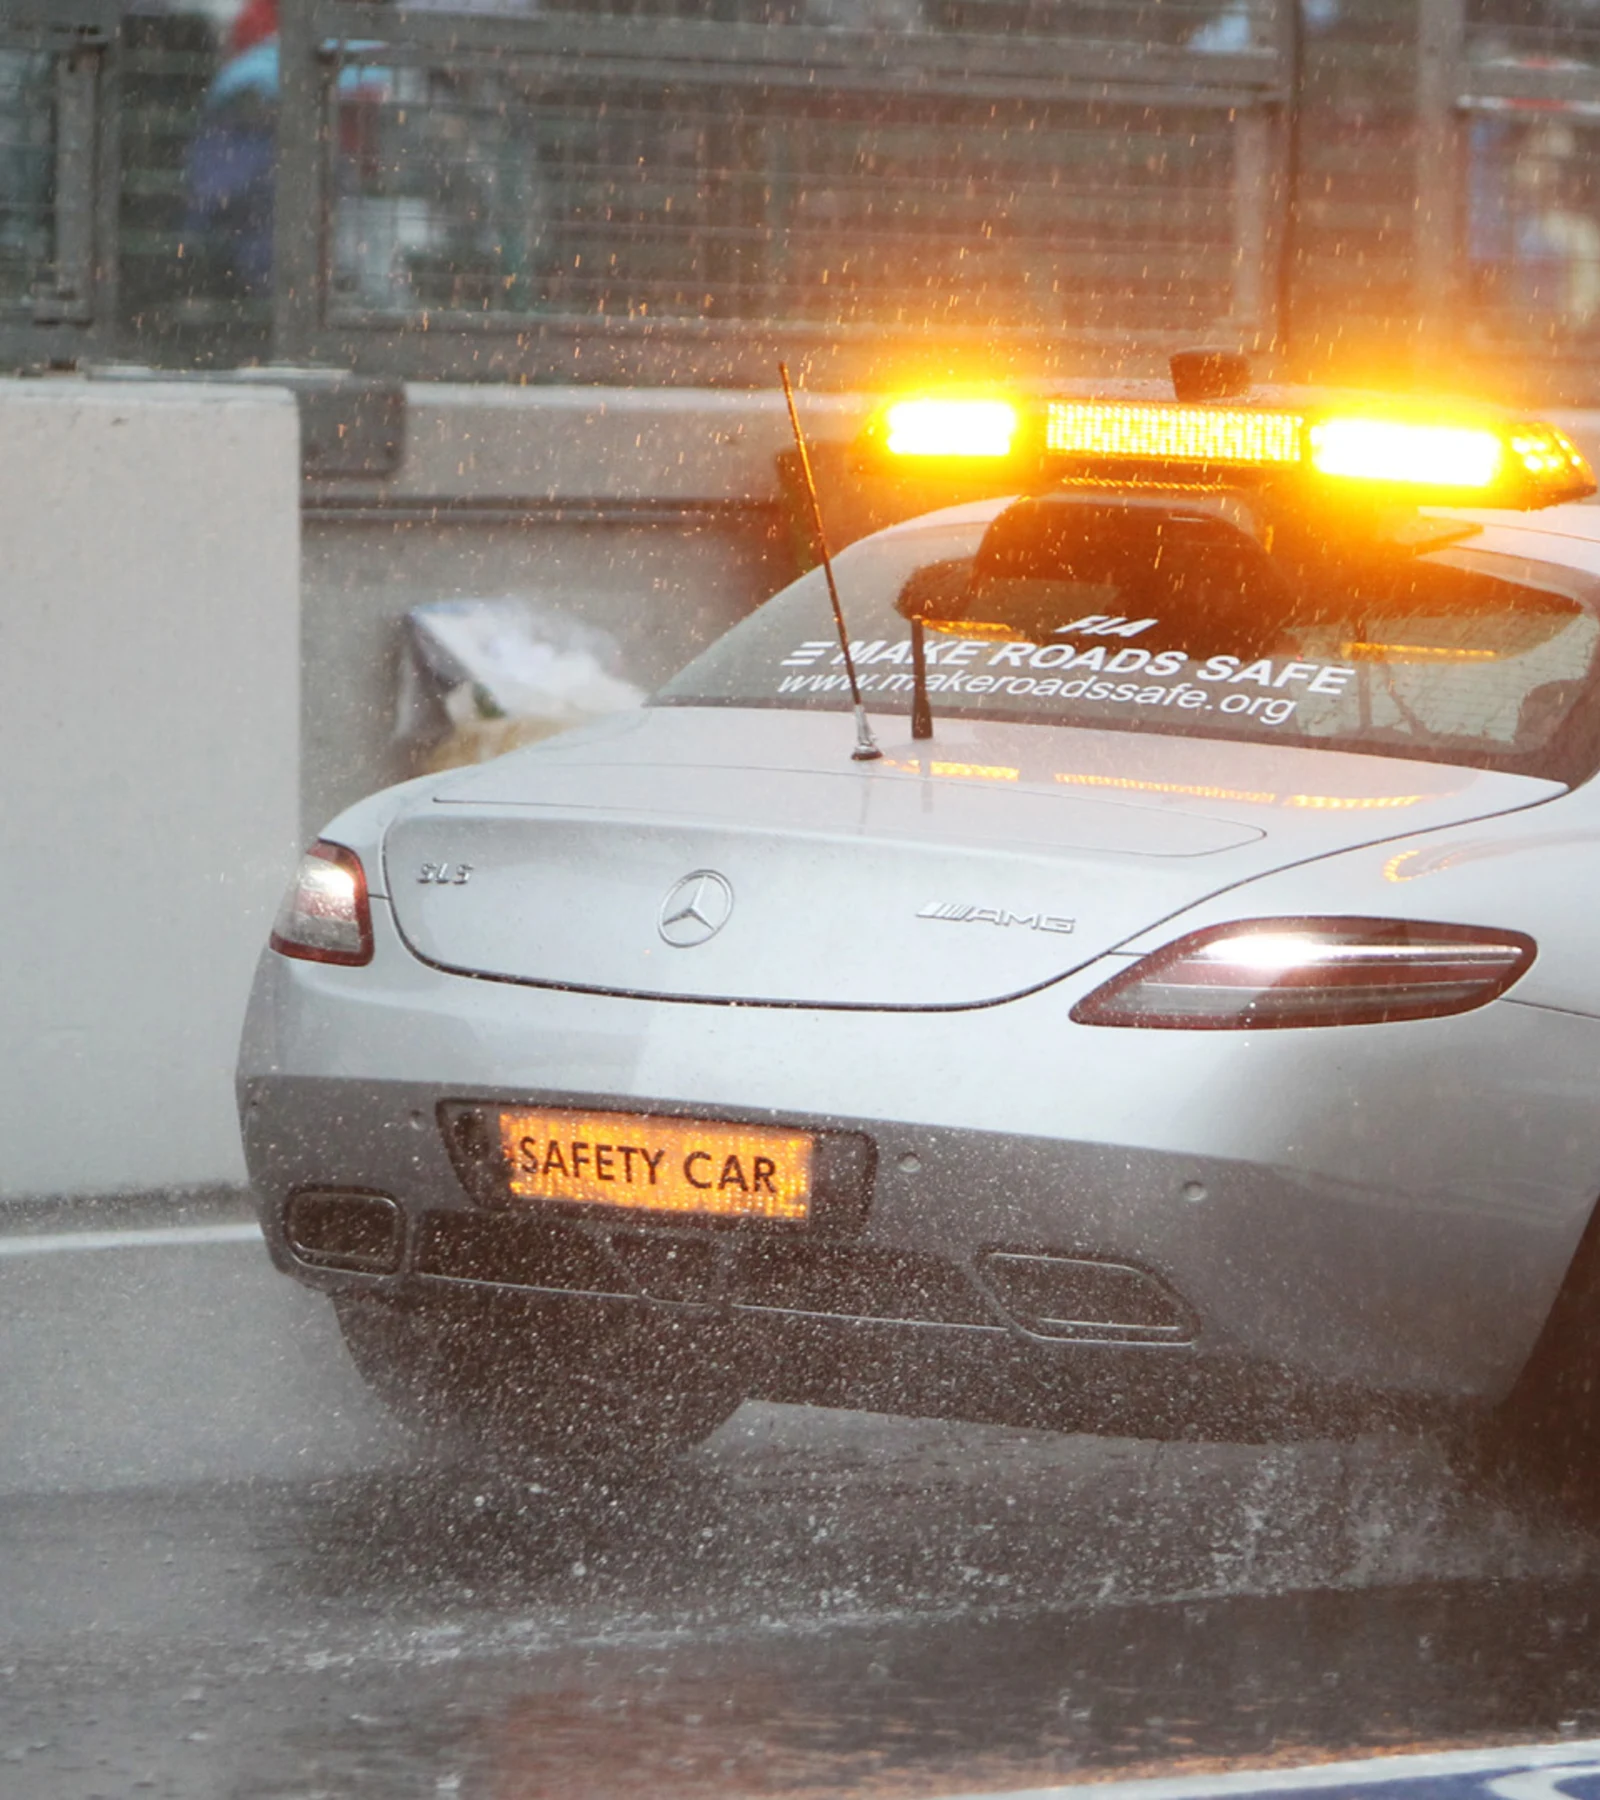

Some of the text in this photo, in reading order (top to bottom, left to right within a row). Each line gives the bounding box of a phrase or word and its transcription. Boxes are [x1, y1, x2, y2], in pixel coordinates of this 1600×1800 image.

[1054, 614, 1159, 638] FIA
[829, 640, 1357, 695] MAKE ROADS SAFE
[776, 669, 1299, 726] www.makeroadssafe.org
[416, 861, 475, 885] SLS
[519, 1135, 777, 1194] SAFETY CAR
